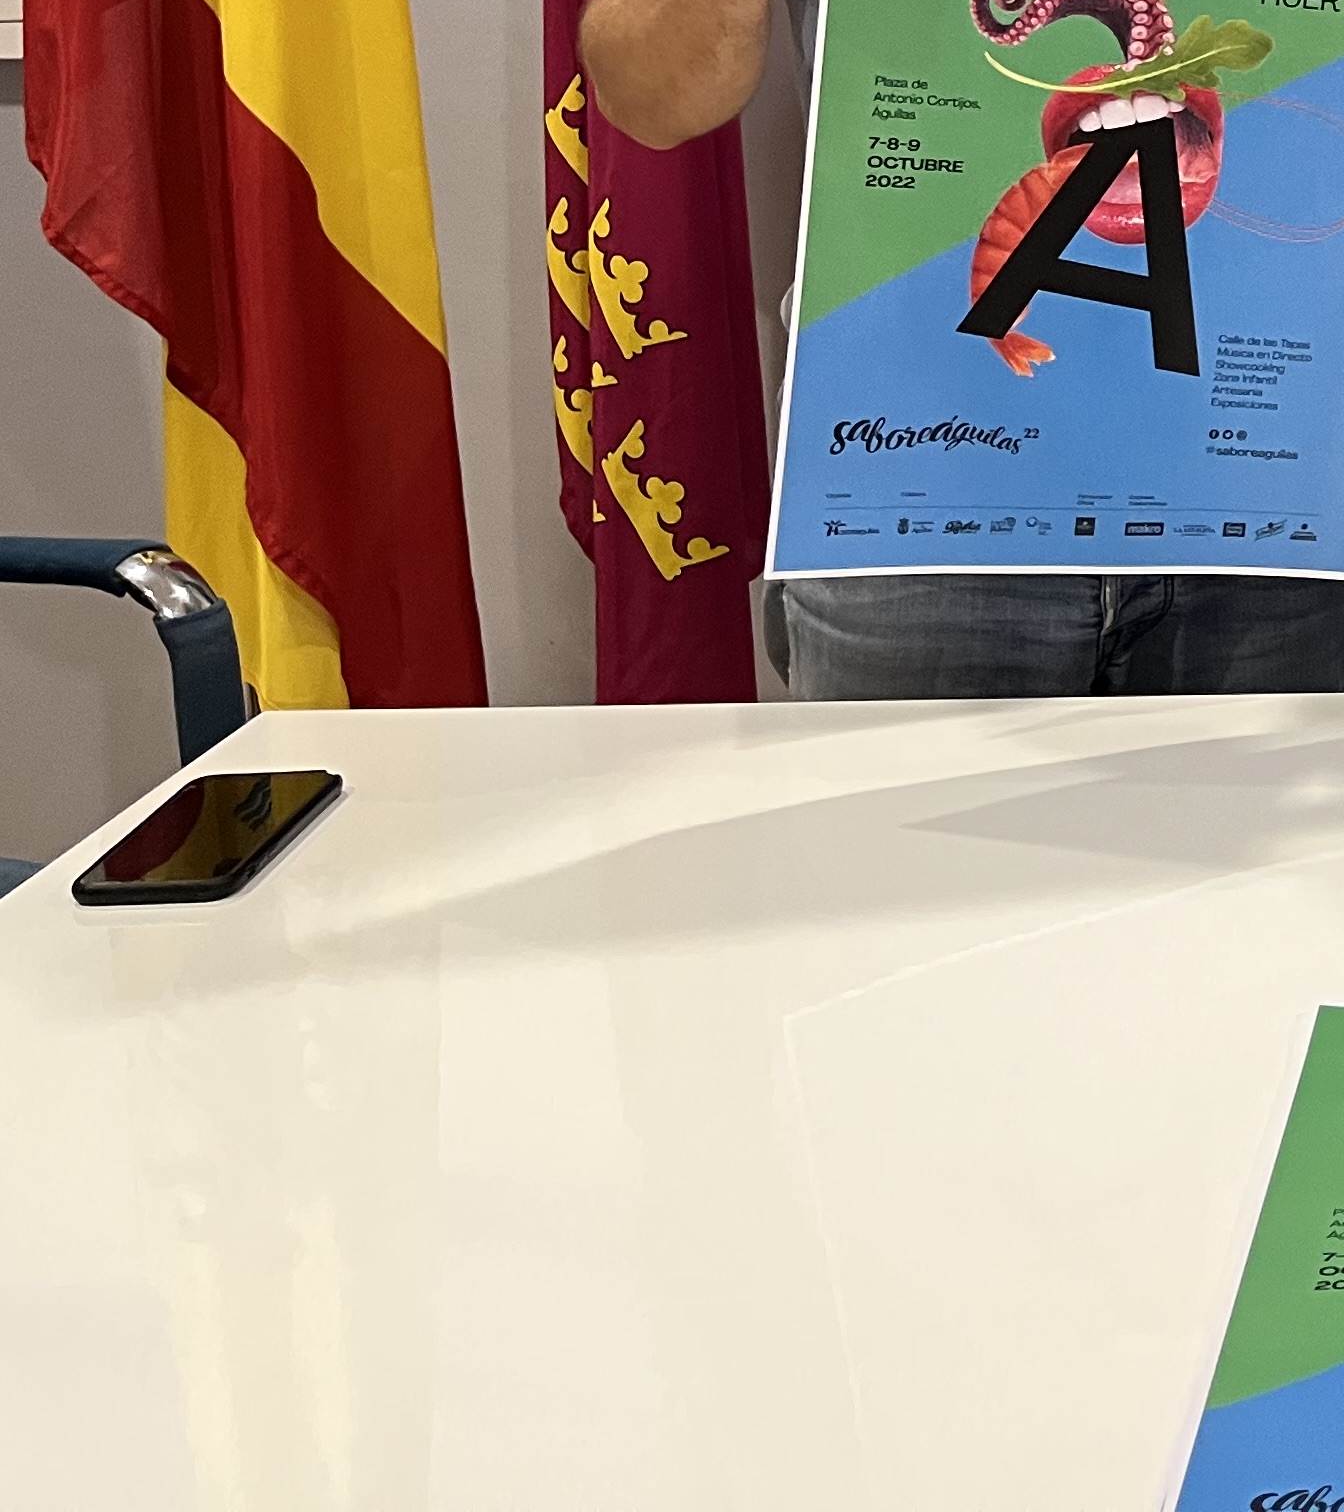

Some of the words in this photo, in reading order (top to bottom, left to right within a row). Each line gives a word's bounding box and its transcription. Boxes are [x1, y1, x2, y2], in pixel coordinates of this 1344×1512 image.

[874, 75, 908, 88] Plaza
[911, 80, 929, 90] de
[873, 92, 924, 105] Antonio
[868, 137, 921, 152] 7-8-9
[867, 155, 964, 173] OCTUBRE
[865, 174, 916, 189] 2022
